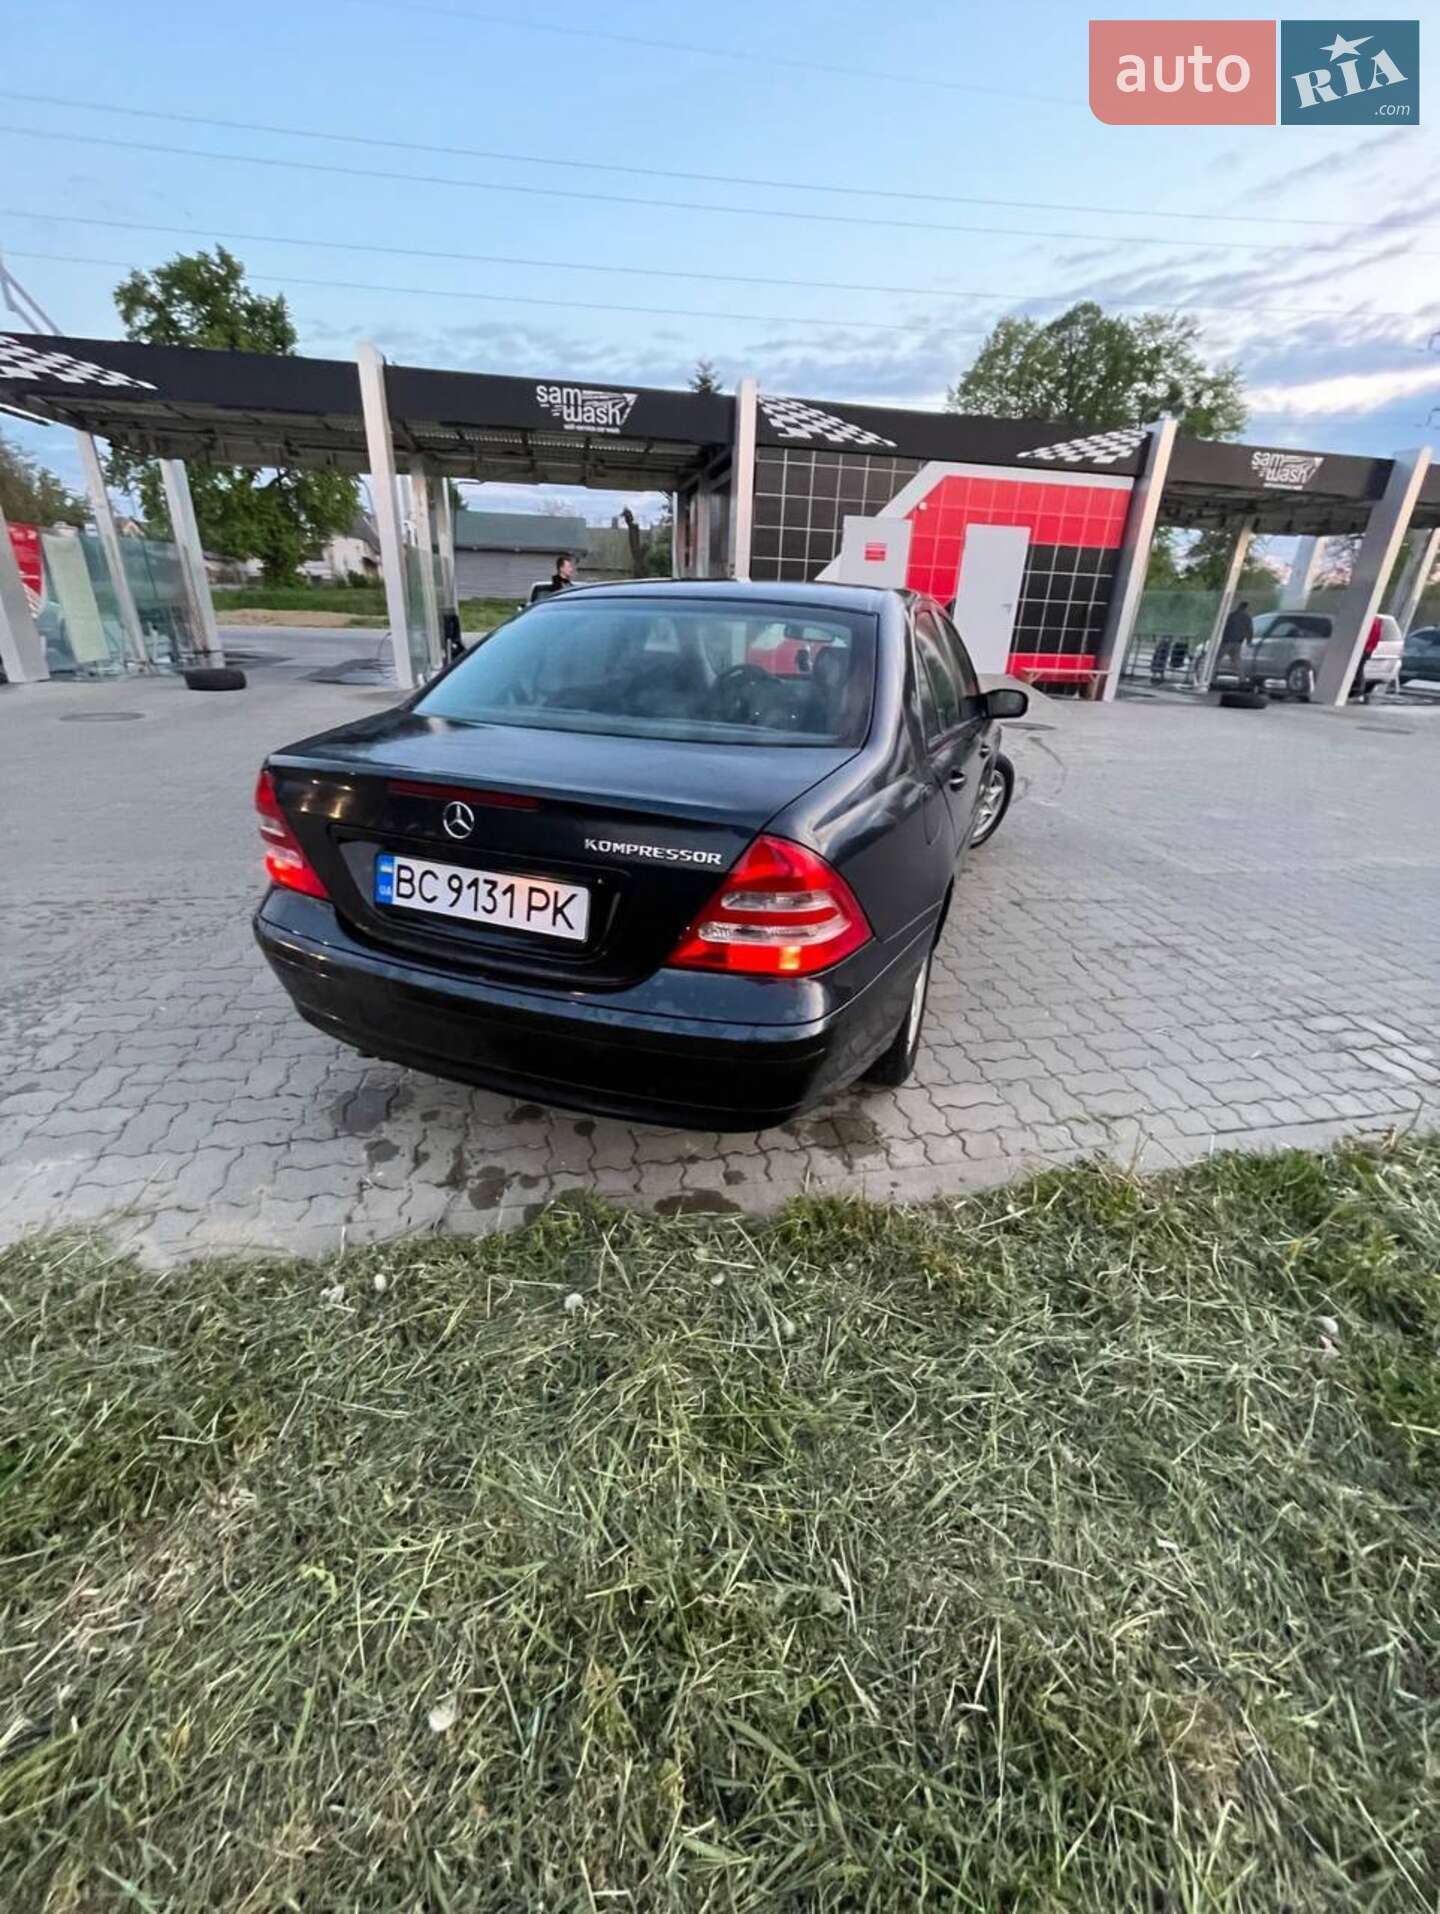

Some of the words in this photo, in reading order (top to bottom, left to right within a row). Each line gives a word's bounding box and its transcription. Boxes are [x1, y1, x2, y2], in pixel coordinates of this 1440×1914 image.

[536, 385, 582, 406] sam
[563, 402, 621, 426] wash
[1251, 451, 1284, 467] sam
[1265, 464, 1308, 484] wash
[584, 838, 722, 865] KOMPRESSOR
[396, 864, 438, 903] BC
[447, 874, 515, 919] 9131
[526, 887, 578, 930] PK
